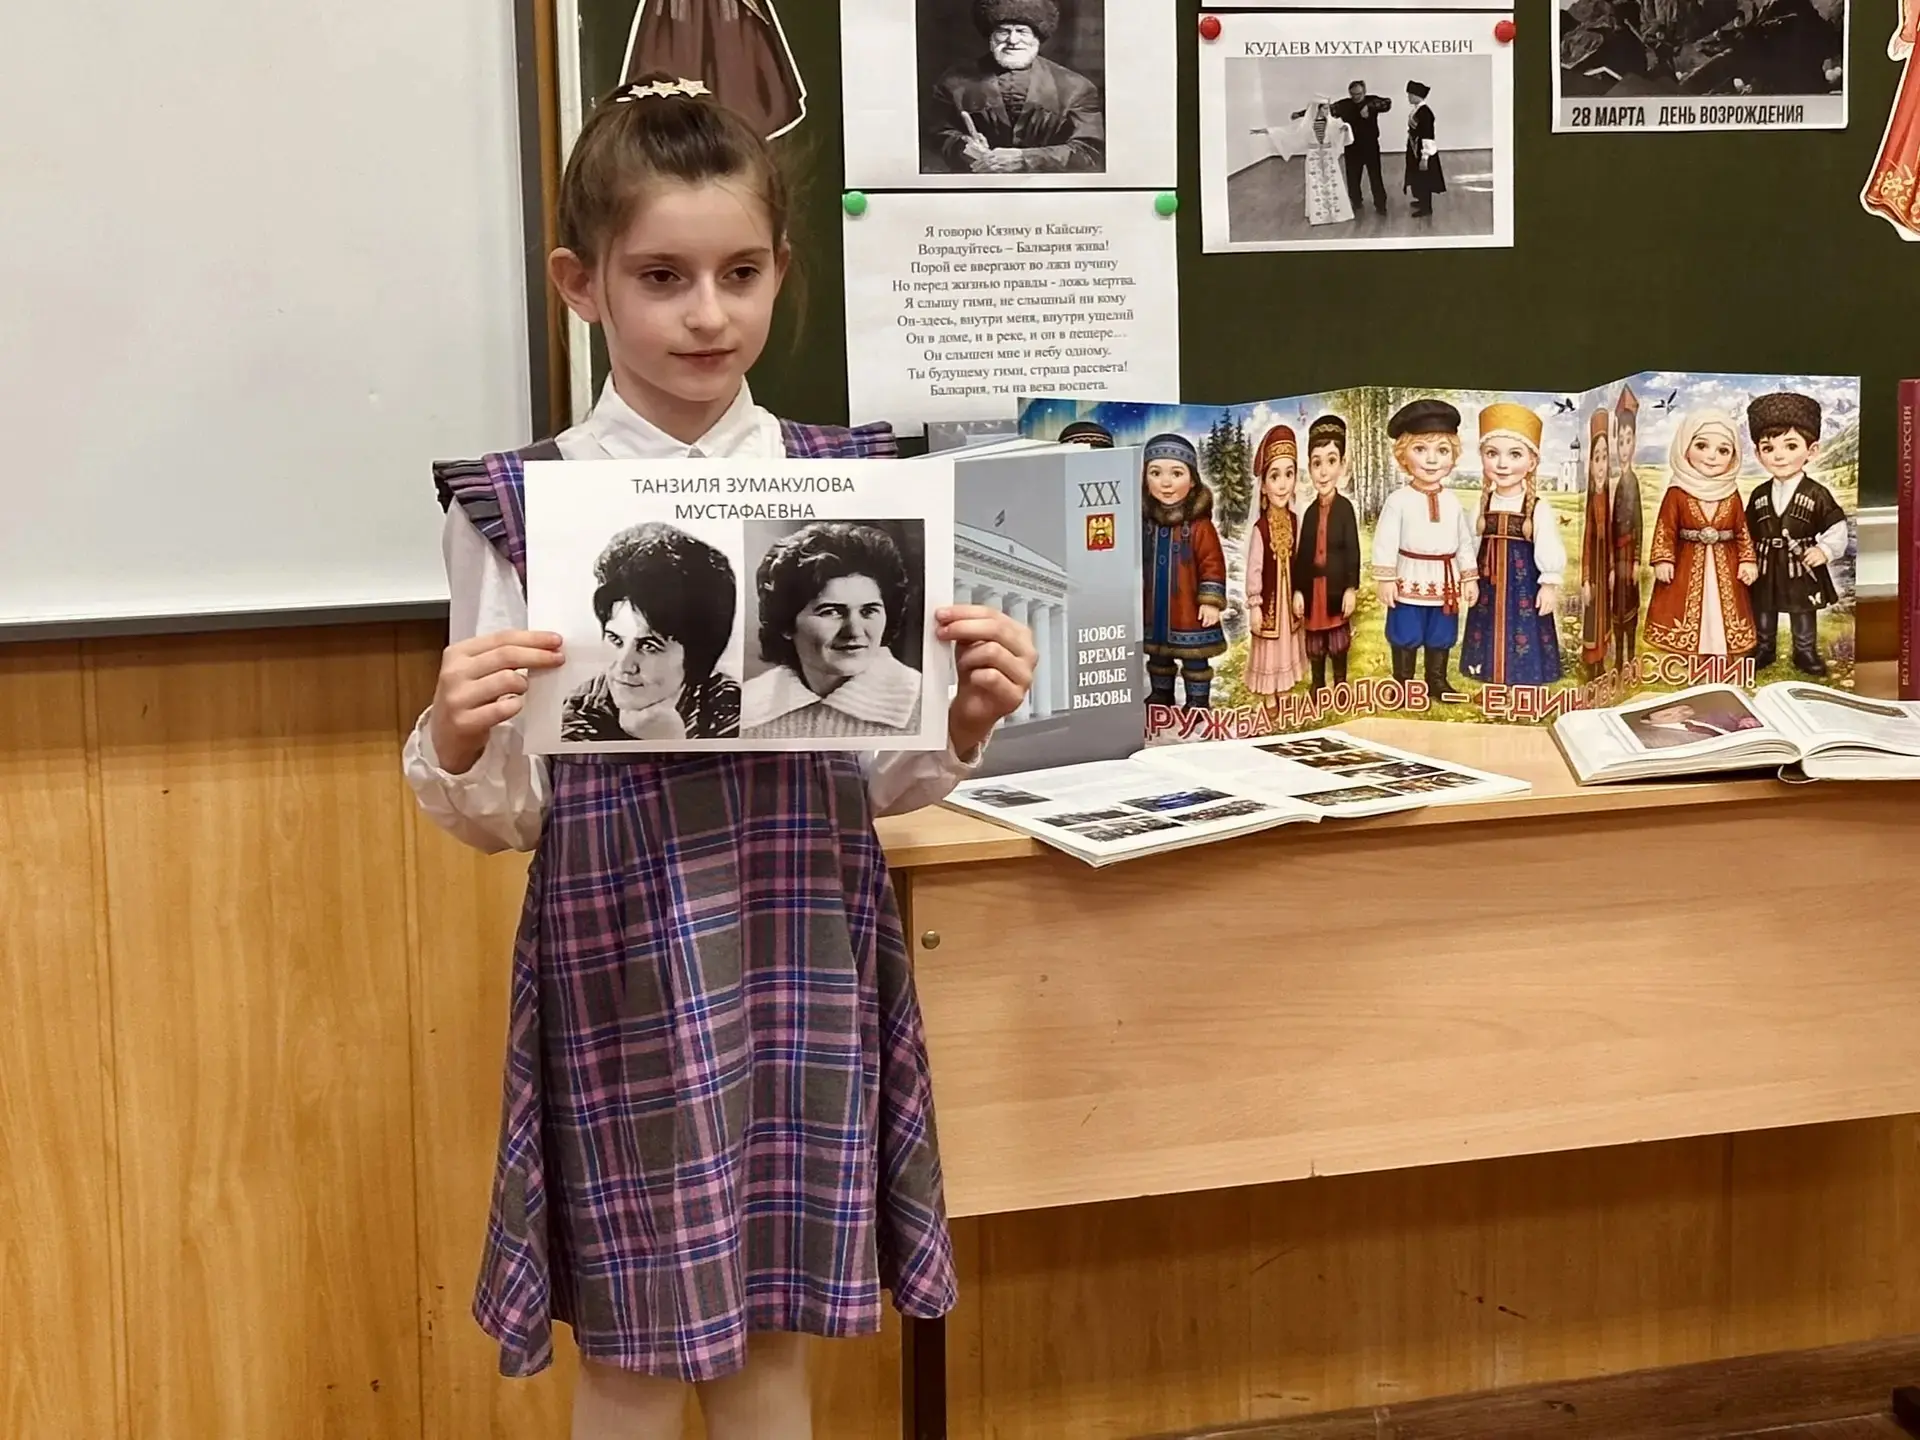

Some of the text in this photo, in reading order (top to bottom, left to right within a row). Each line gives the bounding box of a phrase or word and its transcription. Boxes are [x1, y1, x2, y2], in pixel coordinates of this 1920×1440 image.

[1244, 39, 1473, 57] КУДАЕВ МУХТАР ЧУКАЕВИЧ
[1572, 105, 1804, 127] 28 МАРТА ДЕНЬ ВОЗРОЖДЕНИЯ
[925, 226, 934, 237] Я
[938, 228, 982, 239] говорю
[986, 225, 1032, 238] Кязиму
[1035, 226, 1042, 235] и
[918, 243, 1003, 257] Возрадуйтесь
[1016, 242, 1072, 255] Балкария
[1075, 240, 1109, 252] жива!
[911, 260, 1118, 275] Порой ее ввергают во лжи пучину
[892, 280, 910, 292] Но
[913, 281, 949, 294] перед
[952, 280, 1000, 290] жизнью
[1003, 279, 1047, 292] правды
[1058, 279, 1089, 288] ложь
[904, 294, 1126, 310] Я слышу гимн, не слышный ни кому
[897, 309, 1134, 327] Он-здесь, внутри меня, внутри ущелий
[906, 332, 924, 344] Он
[928, 335, 935, 343] в
[938, 333, 972, 344] доме,
[975, 333, 983, 342] и
[986, 333, 993, 341] в
[996, 332, 1027, 344] реке,
[1030, 332, 1037, 340] и
[1041, 331, 1055, 340] он
[1059, 331, 1066, 339] в
[924, 349, 942, 361] Он
[945, 350, 994, 360] слышен
[997, 350, 1020, 358] мне
[1024, 350, 1030, 358] и
[1034, 346, 1062, 359] небу
[907, 361, 1128, 381] Ты будущему гимн, страна рассвета!
[930, 381, 1108, 397] Балкария, ты на века воспета.
[1902, 405, 1912, 460] РОССИИ
[631, 477, 855, 494] ТАНЗИЛЯ ЗУМАКУЛОВА
[1902, 462, 1912, 505] ЛАГО
[675, 503, 816, 519] МУСТАФАЕВНА
[1078, 625, 1126, 643] НОВОЕ
[1079, 667, 1127, 687] НОВЫЕ
[1073, 688, 1132, 709] ВЫЗОВЫ
[1145, 704, 1271, 741] РУЖБА
[1279, 678, 1430, 729] НАРОДОВ
